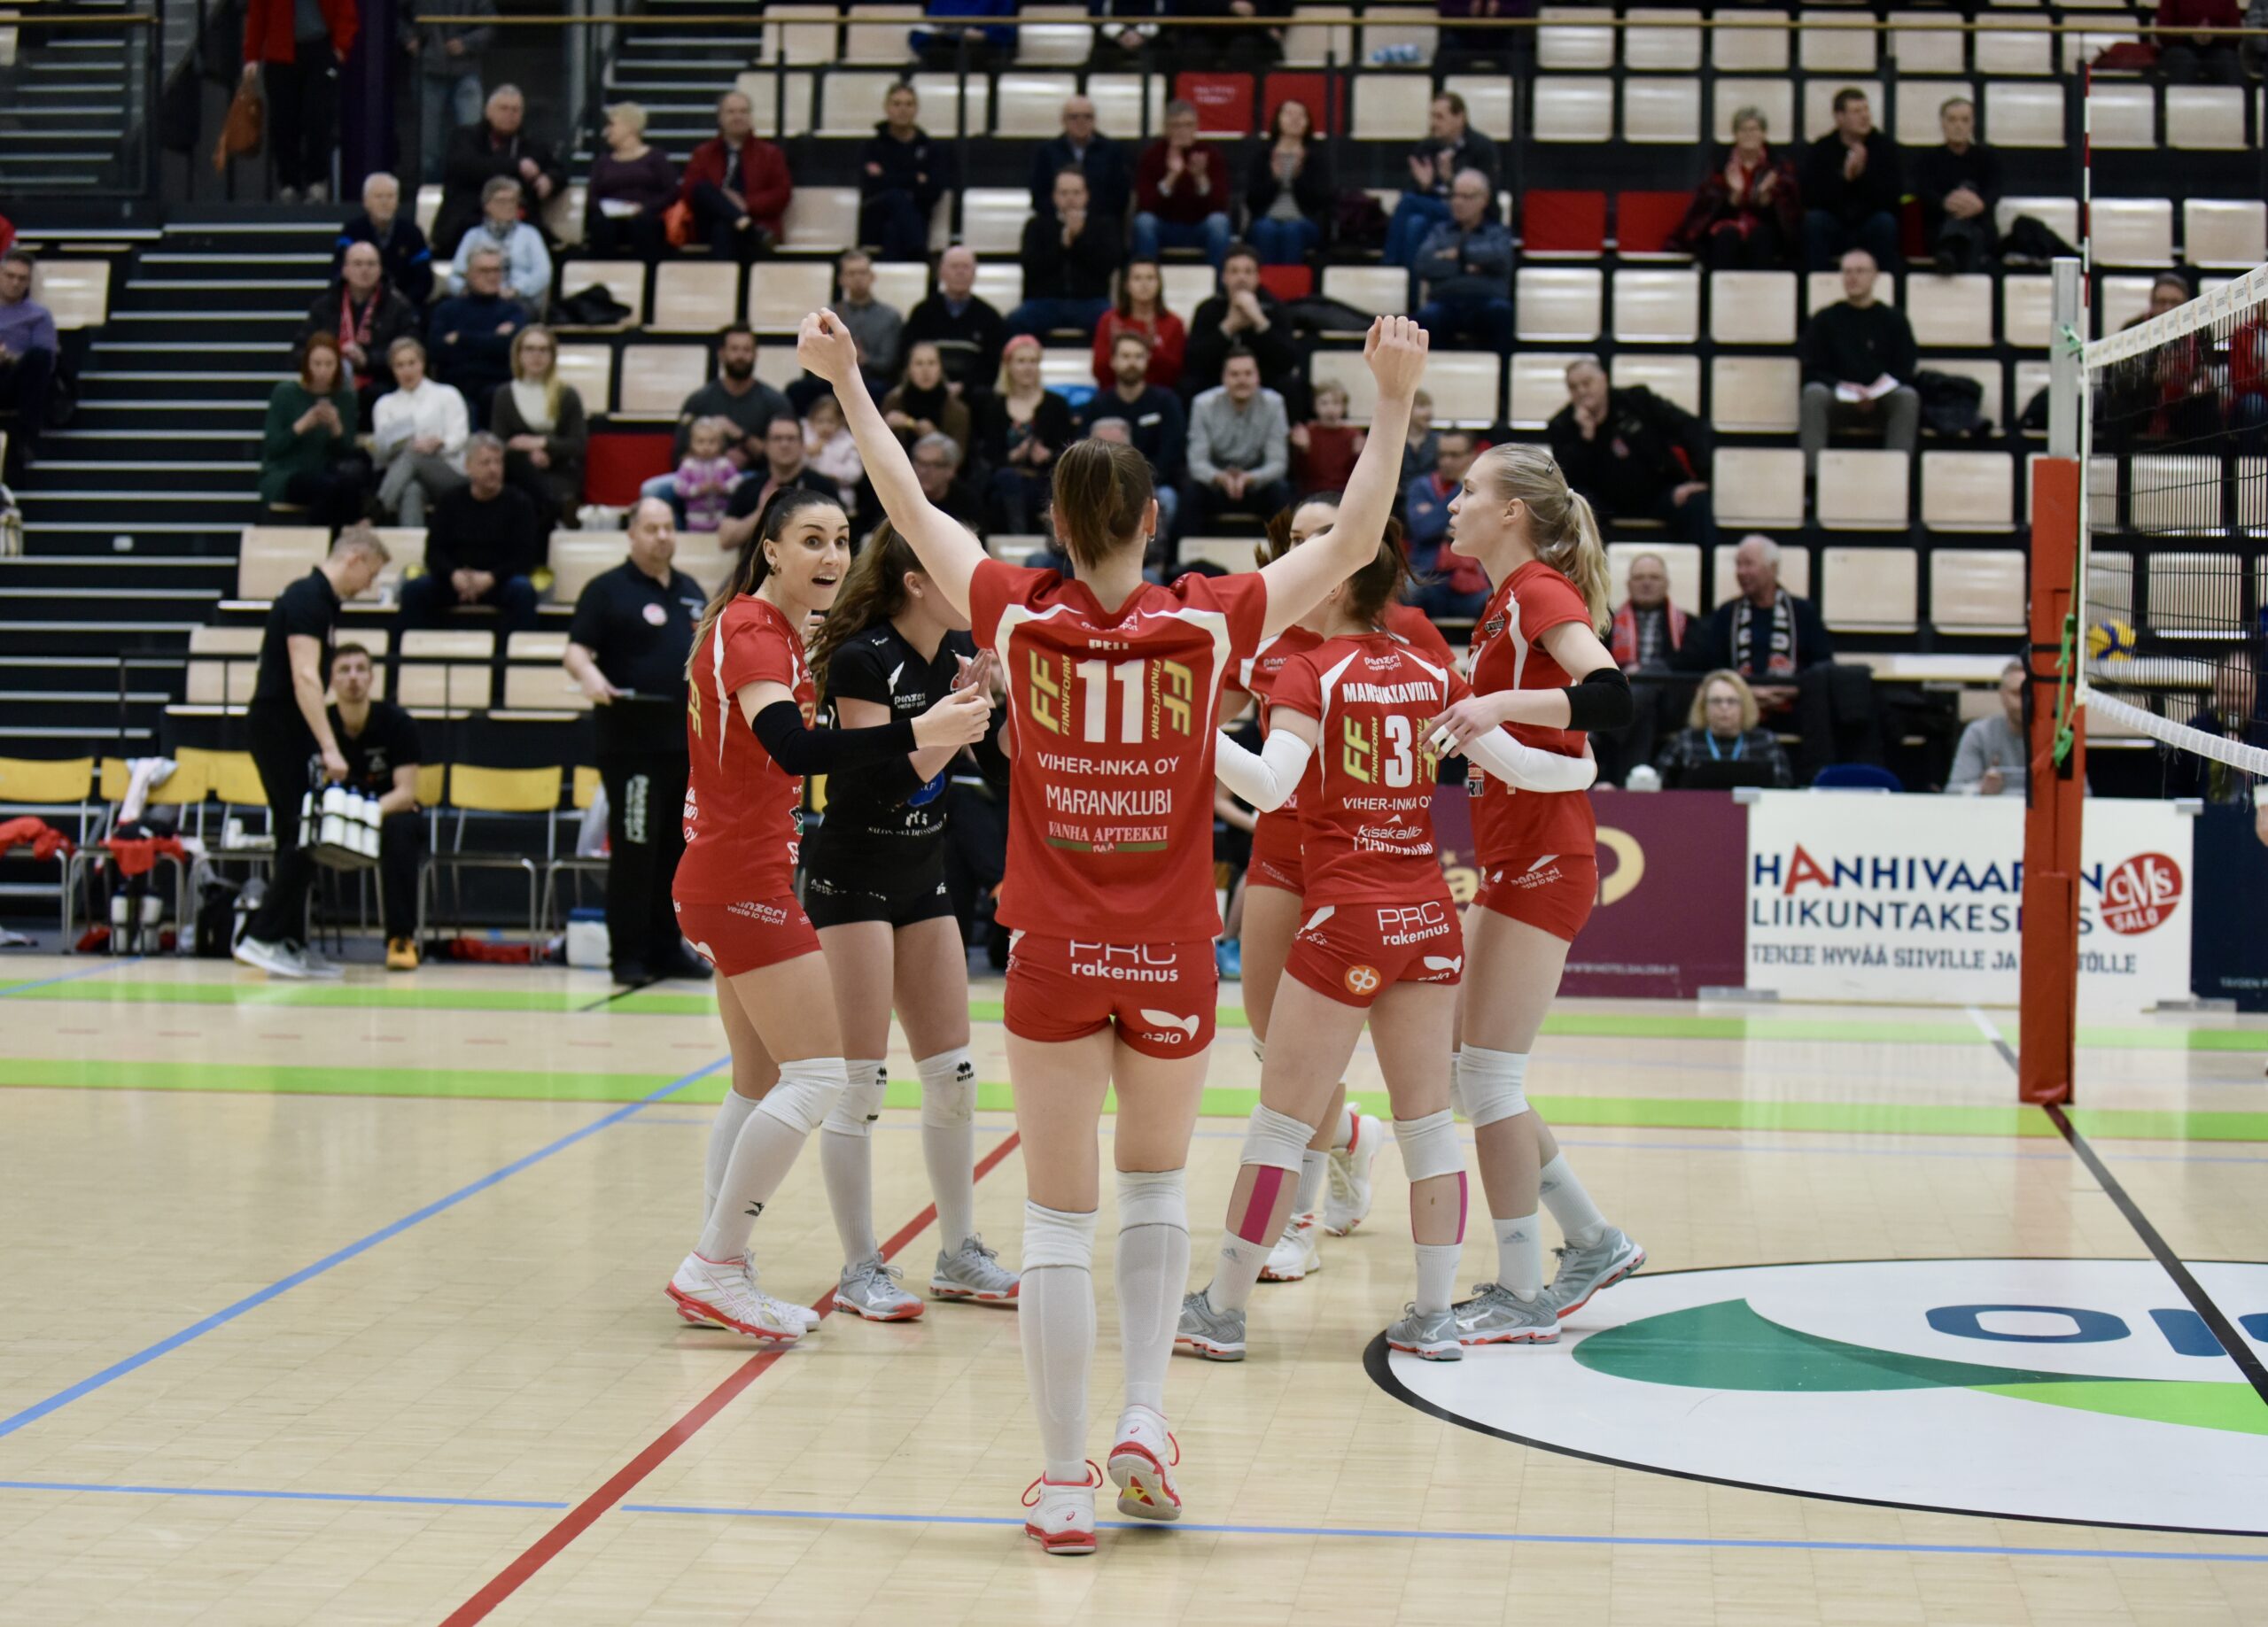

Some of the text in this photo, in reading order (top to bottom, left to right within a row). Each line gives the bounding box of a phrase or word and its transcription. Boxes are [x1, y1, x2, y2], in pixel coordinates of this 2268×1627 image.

[1061, 655, 1071, 736] FINNFORM
[1076, 658, 1146, 744] 11
[1152, 659, 1161, 740] FINNFORM
[1037, 751, 1180, 776] VIHER-INKA OY
[1385, 715, 1413, 787] 3
[1045, 783, 1172, 817] MARANKLUBI
[1342, 796, 1418, 810] VIHER-INKA
[1048, 820, 1169, 842] VANHA APTEEKKI
[1376, 901, 1445, 931] PRC
[1382, 923, 1450, 946] rakennus
[1071, 959, 1179, 983] rakennus
[1751, 944, 1815, 965] TEKEE
[1992, 951, 2016, 970] JA
